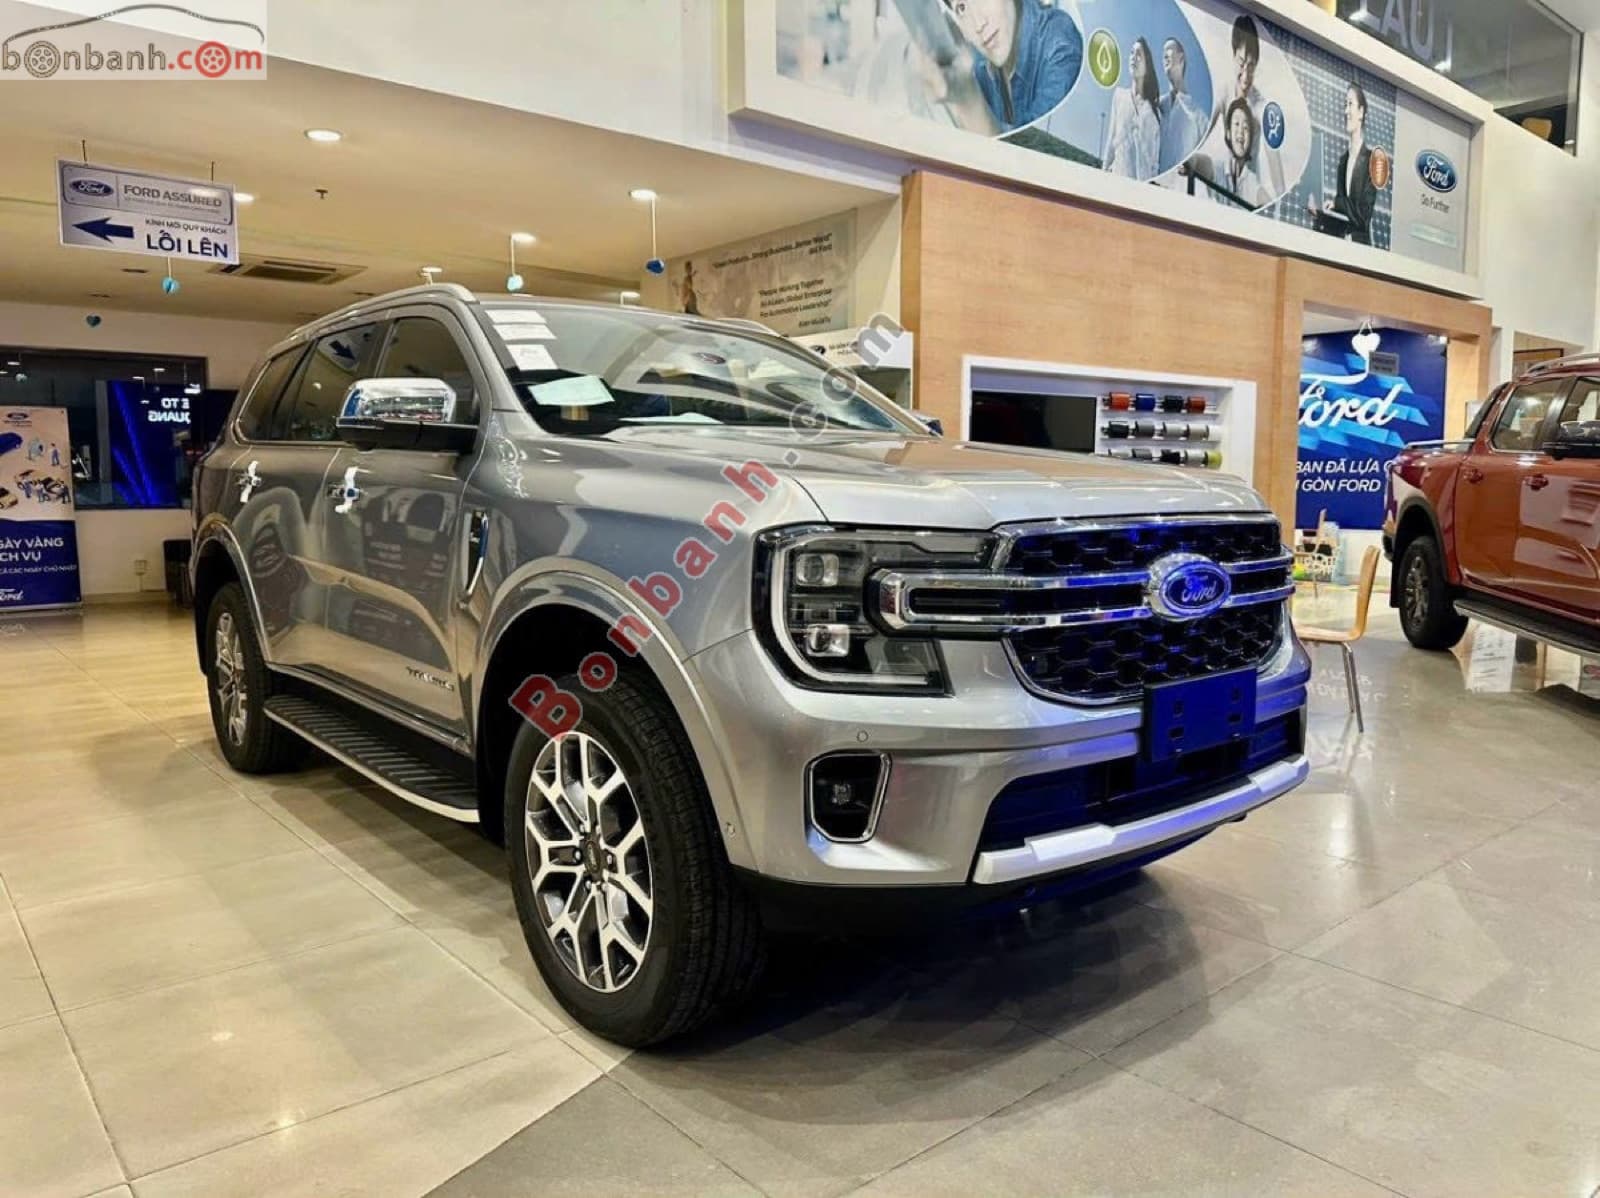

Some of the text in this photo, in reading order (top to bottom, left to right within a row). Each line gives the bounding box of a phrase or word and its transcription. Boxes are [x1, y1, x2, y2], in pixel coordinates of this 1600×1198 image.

[1420, 153, 1453, 189] Ford
[123, 184, 161, 199] FORD
[163, 191, 222, 208] ASSURED
[188, 237, 228, 259] LÊN
[1325, 458, 1346, 473] ĐÃ
[1337, 479, 1381, 493] FORD
[25, 535, 65, 549] VÀNG
[21, 551, 42, 563] VỤ
[1176, 571, 1222, 605] Ford
